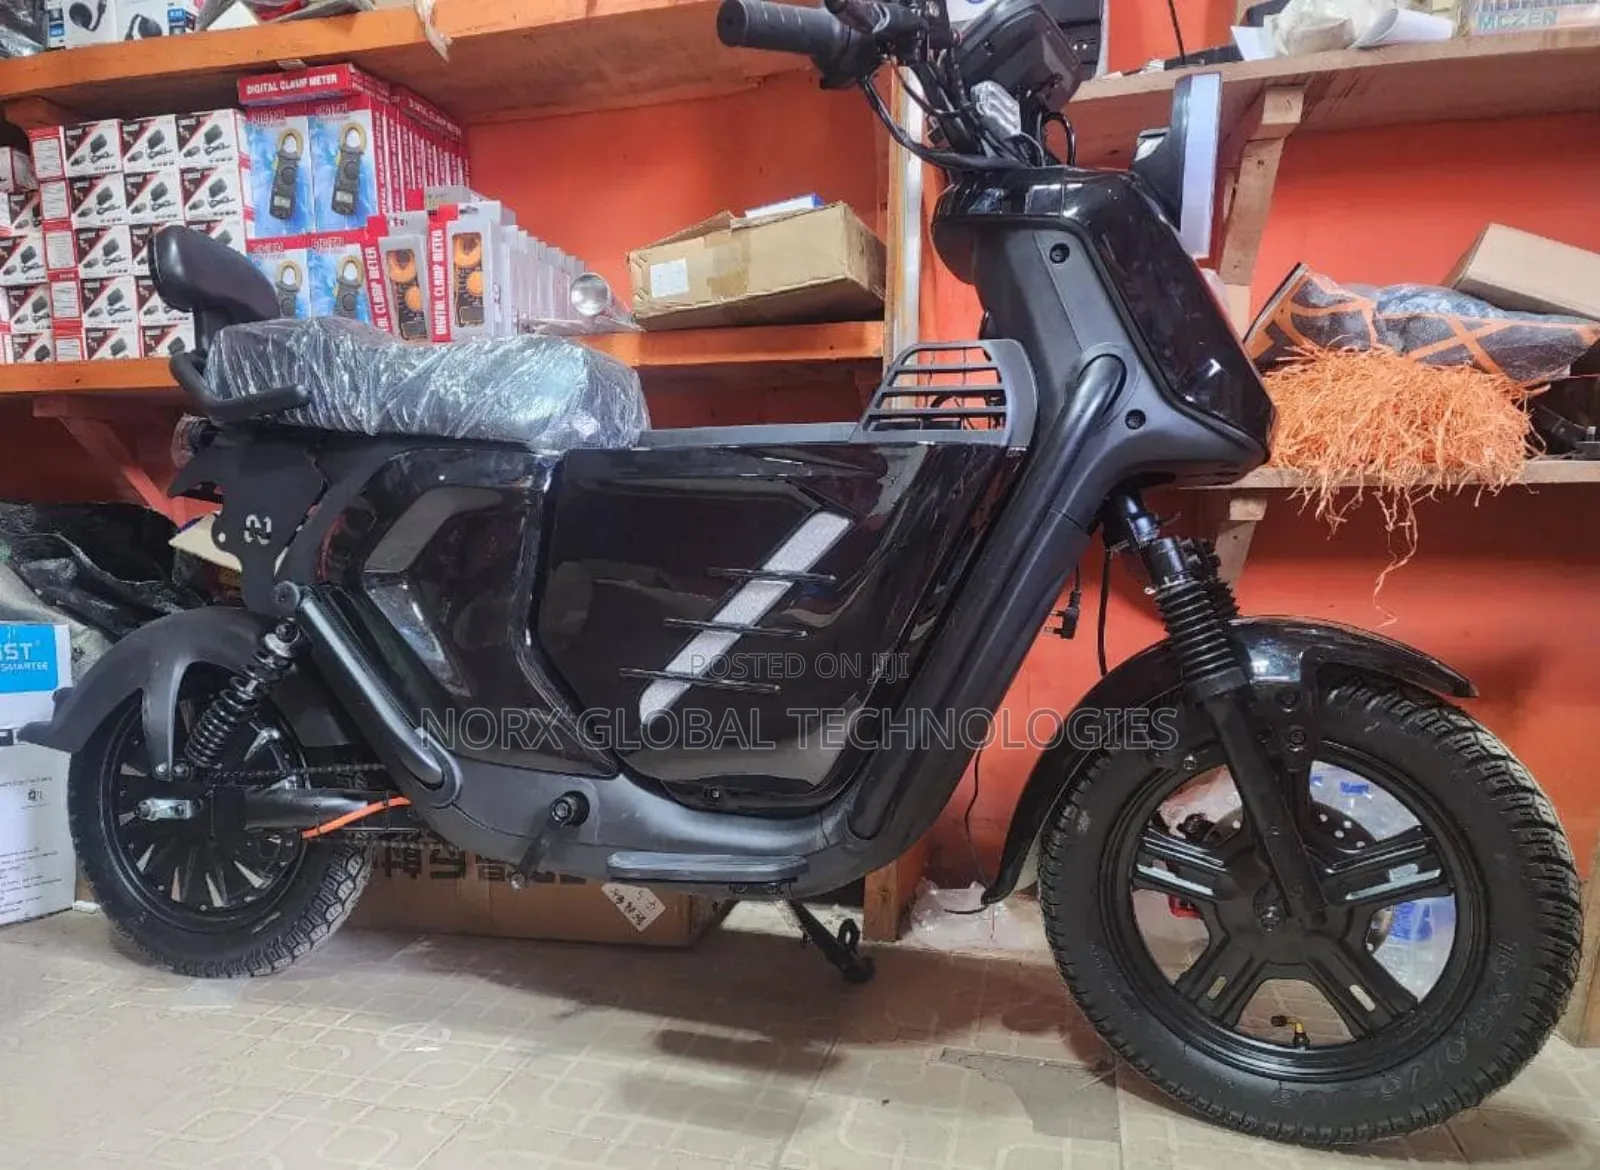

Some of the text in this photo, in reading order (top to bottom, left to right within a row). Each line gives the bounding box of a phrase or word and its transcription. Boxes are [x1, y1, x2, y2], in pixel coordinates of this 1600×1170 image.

[246, 73, 338, 95] DIGITAL CLAMP METER
[364, 247, 380, 280] METER
[431, 229, 448, 335] DIGITAL CLAMP METER
[0, 643, 33, 660] ST
